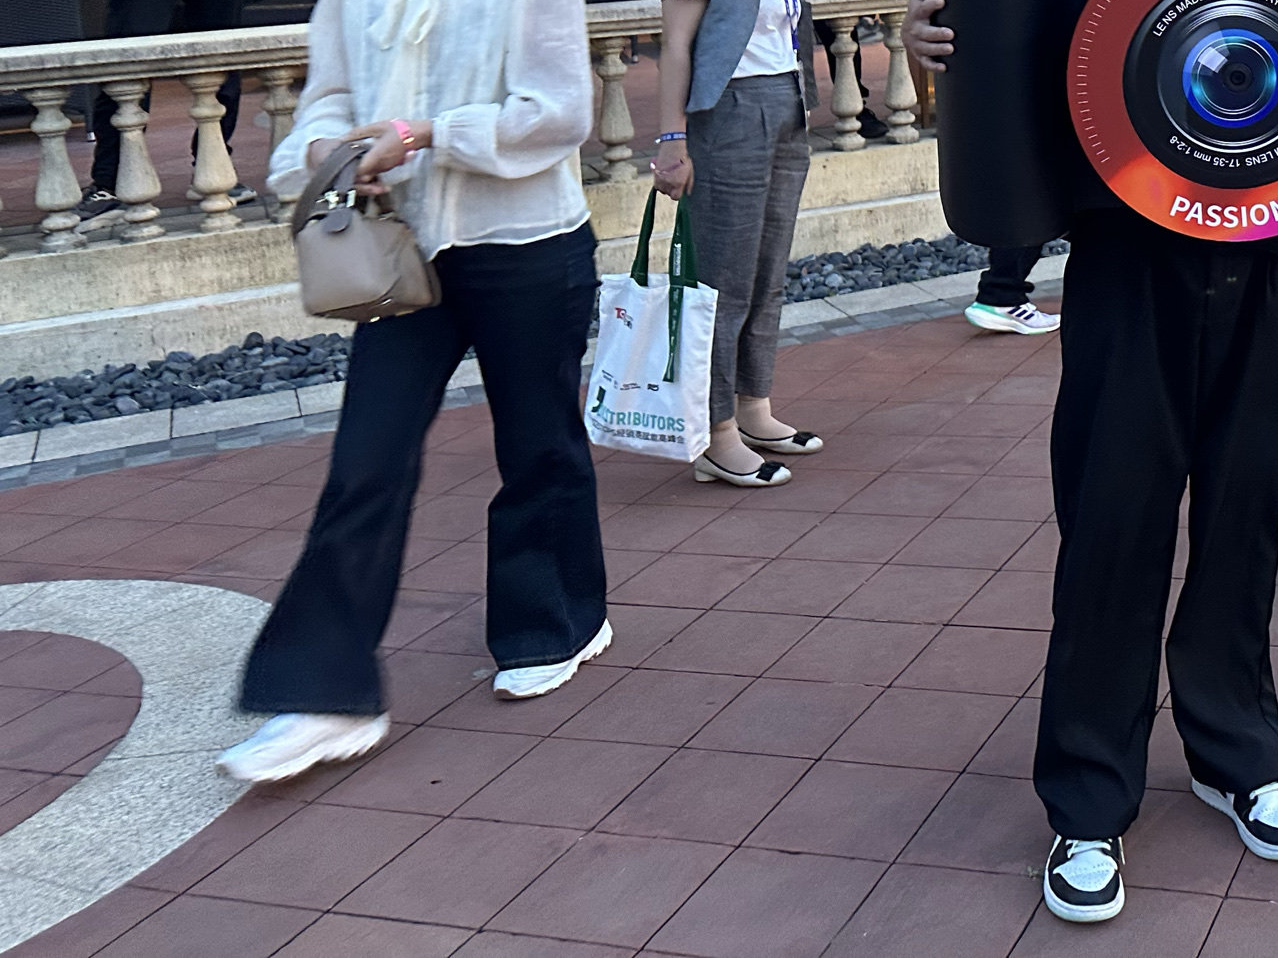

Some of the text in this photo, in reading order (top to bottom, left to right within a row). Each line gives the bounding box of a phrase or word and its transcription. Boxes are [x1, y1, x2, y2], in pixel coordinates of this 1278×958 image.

[1153, 9, 1178, 37] LENS
[1193, 150, 1212, 162] mm
[1212, 156, 1241, 168] 17-35
[1245, 152, 1274, 167] LENS
